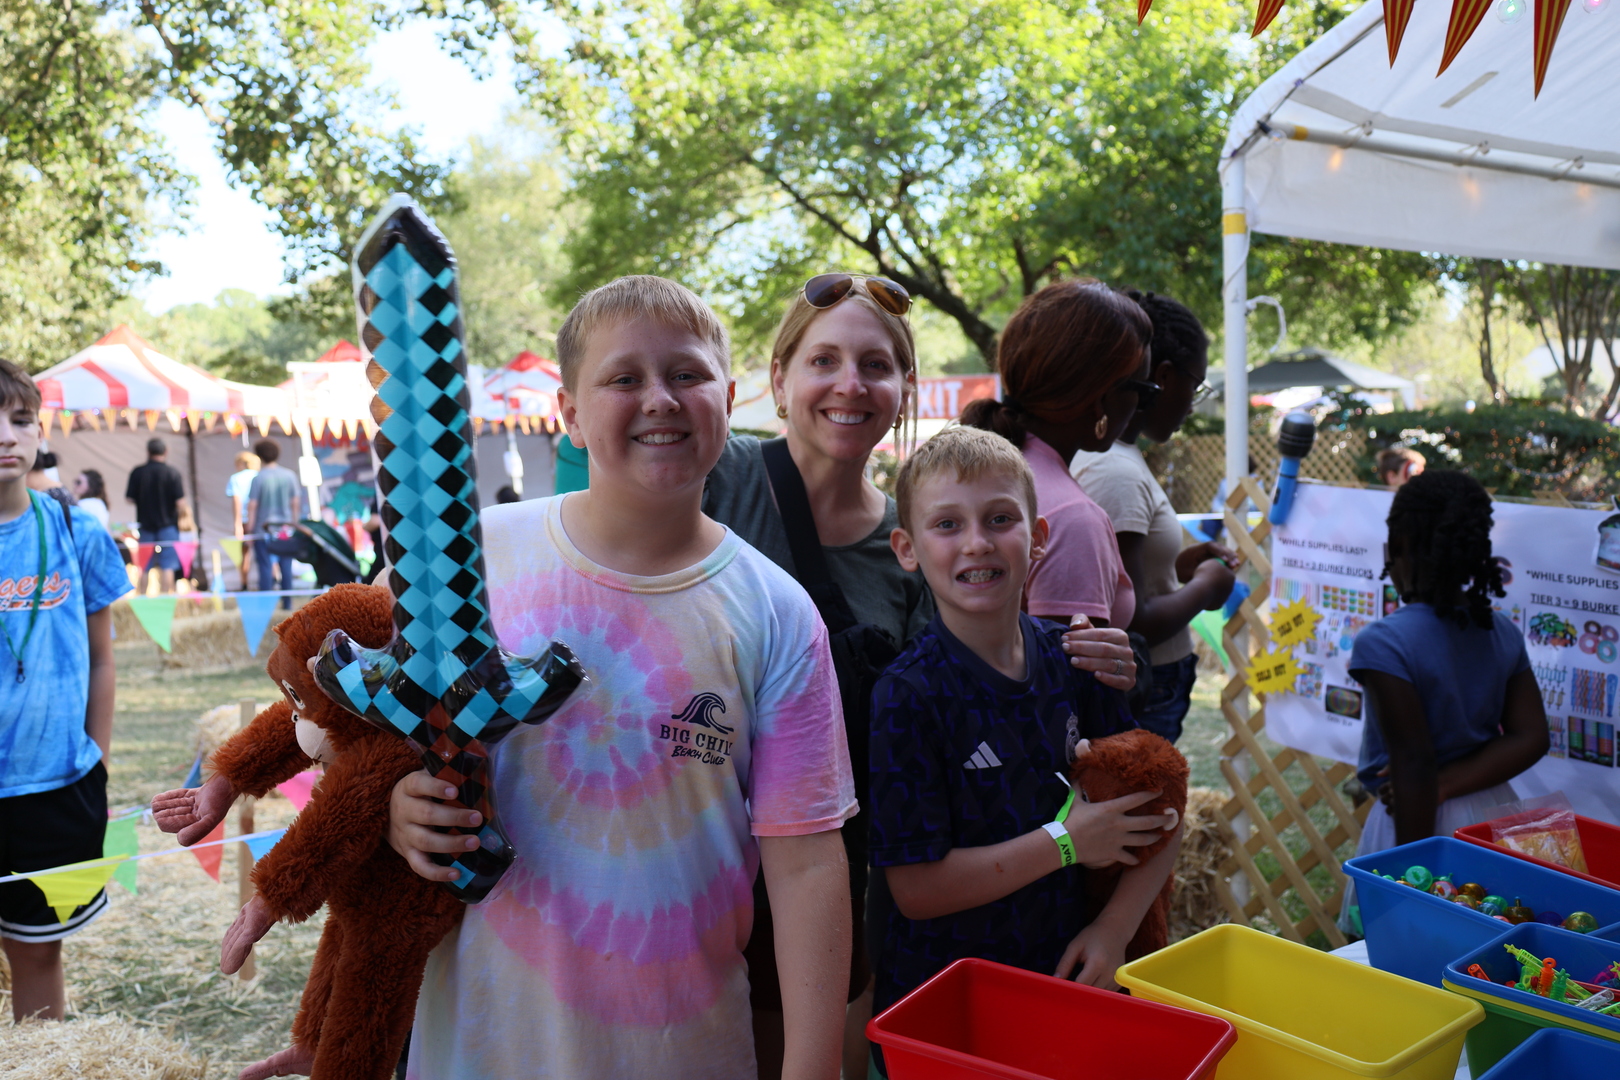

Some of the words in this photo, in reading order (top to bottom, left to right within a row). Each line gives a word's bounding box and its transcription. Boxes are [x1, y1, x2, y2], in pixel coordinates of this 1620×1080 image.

[917, 381, 963, 418] XIT
[1308, 541, 1344, 552] SUPPLIES
[1283, 557, 1297, 567] TIER
[1319, 562, 1344, 574] BURKE
[1347, 566, 1373, 579] BUCKS
[1567, 574, 1619, 590] SUPPLIES
[1531, 593, 1553, 605] TIER
[1555, 596, 1561, 607] 3
[1572, 599, 1579, 608] 9
[1582, 600, 1619, 615] BURKE
[1277, 621, 1292, 637] SOLD
[1293, 613, 1304, 627] OUT
[1256, 668, 1271, 682] SOLD
[1274, 663, 1286, 676] OUT
[659, 724, 690, 743] BIG
[695, 733, 733, 756] CHIL
[671, 745, 702, 760] BEACH
